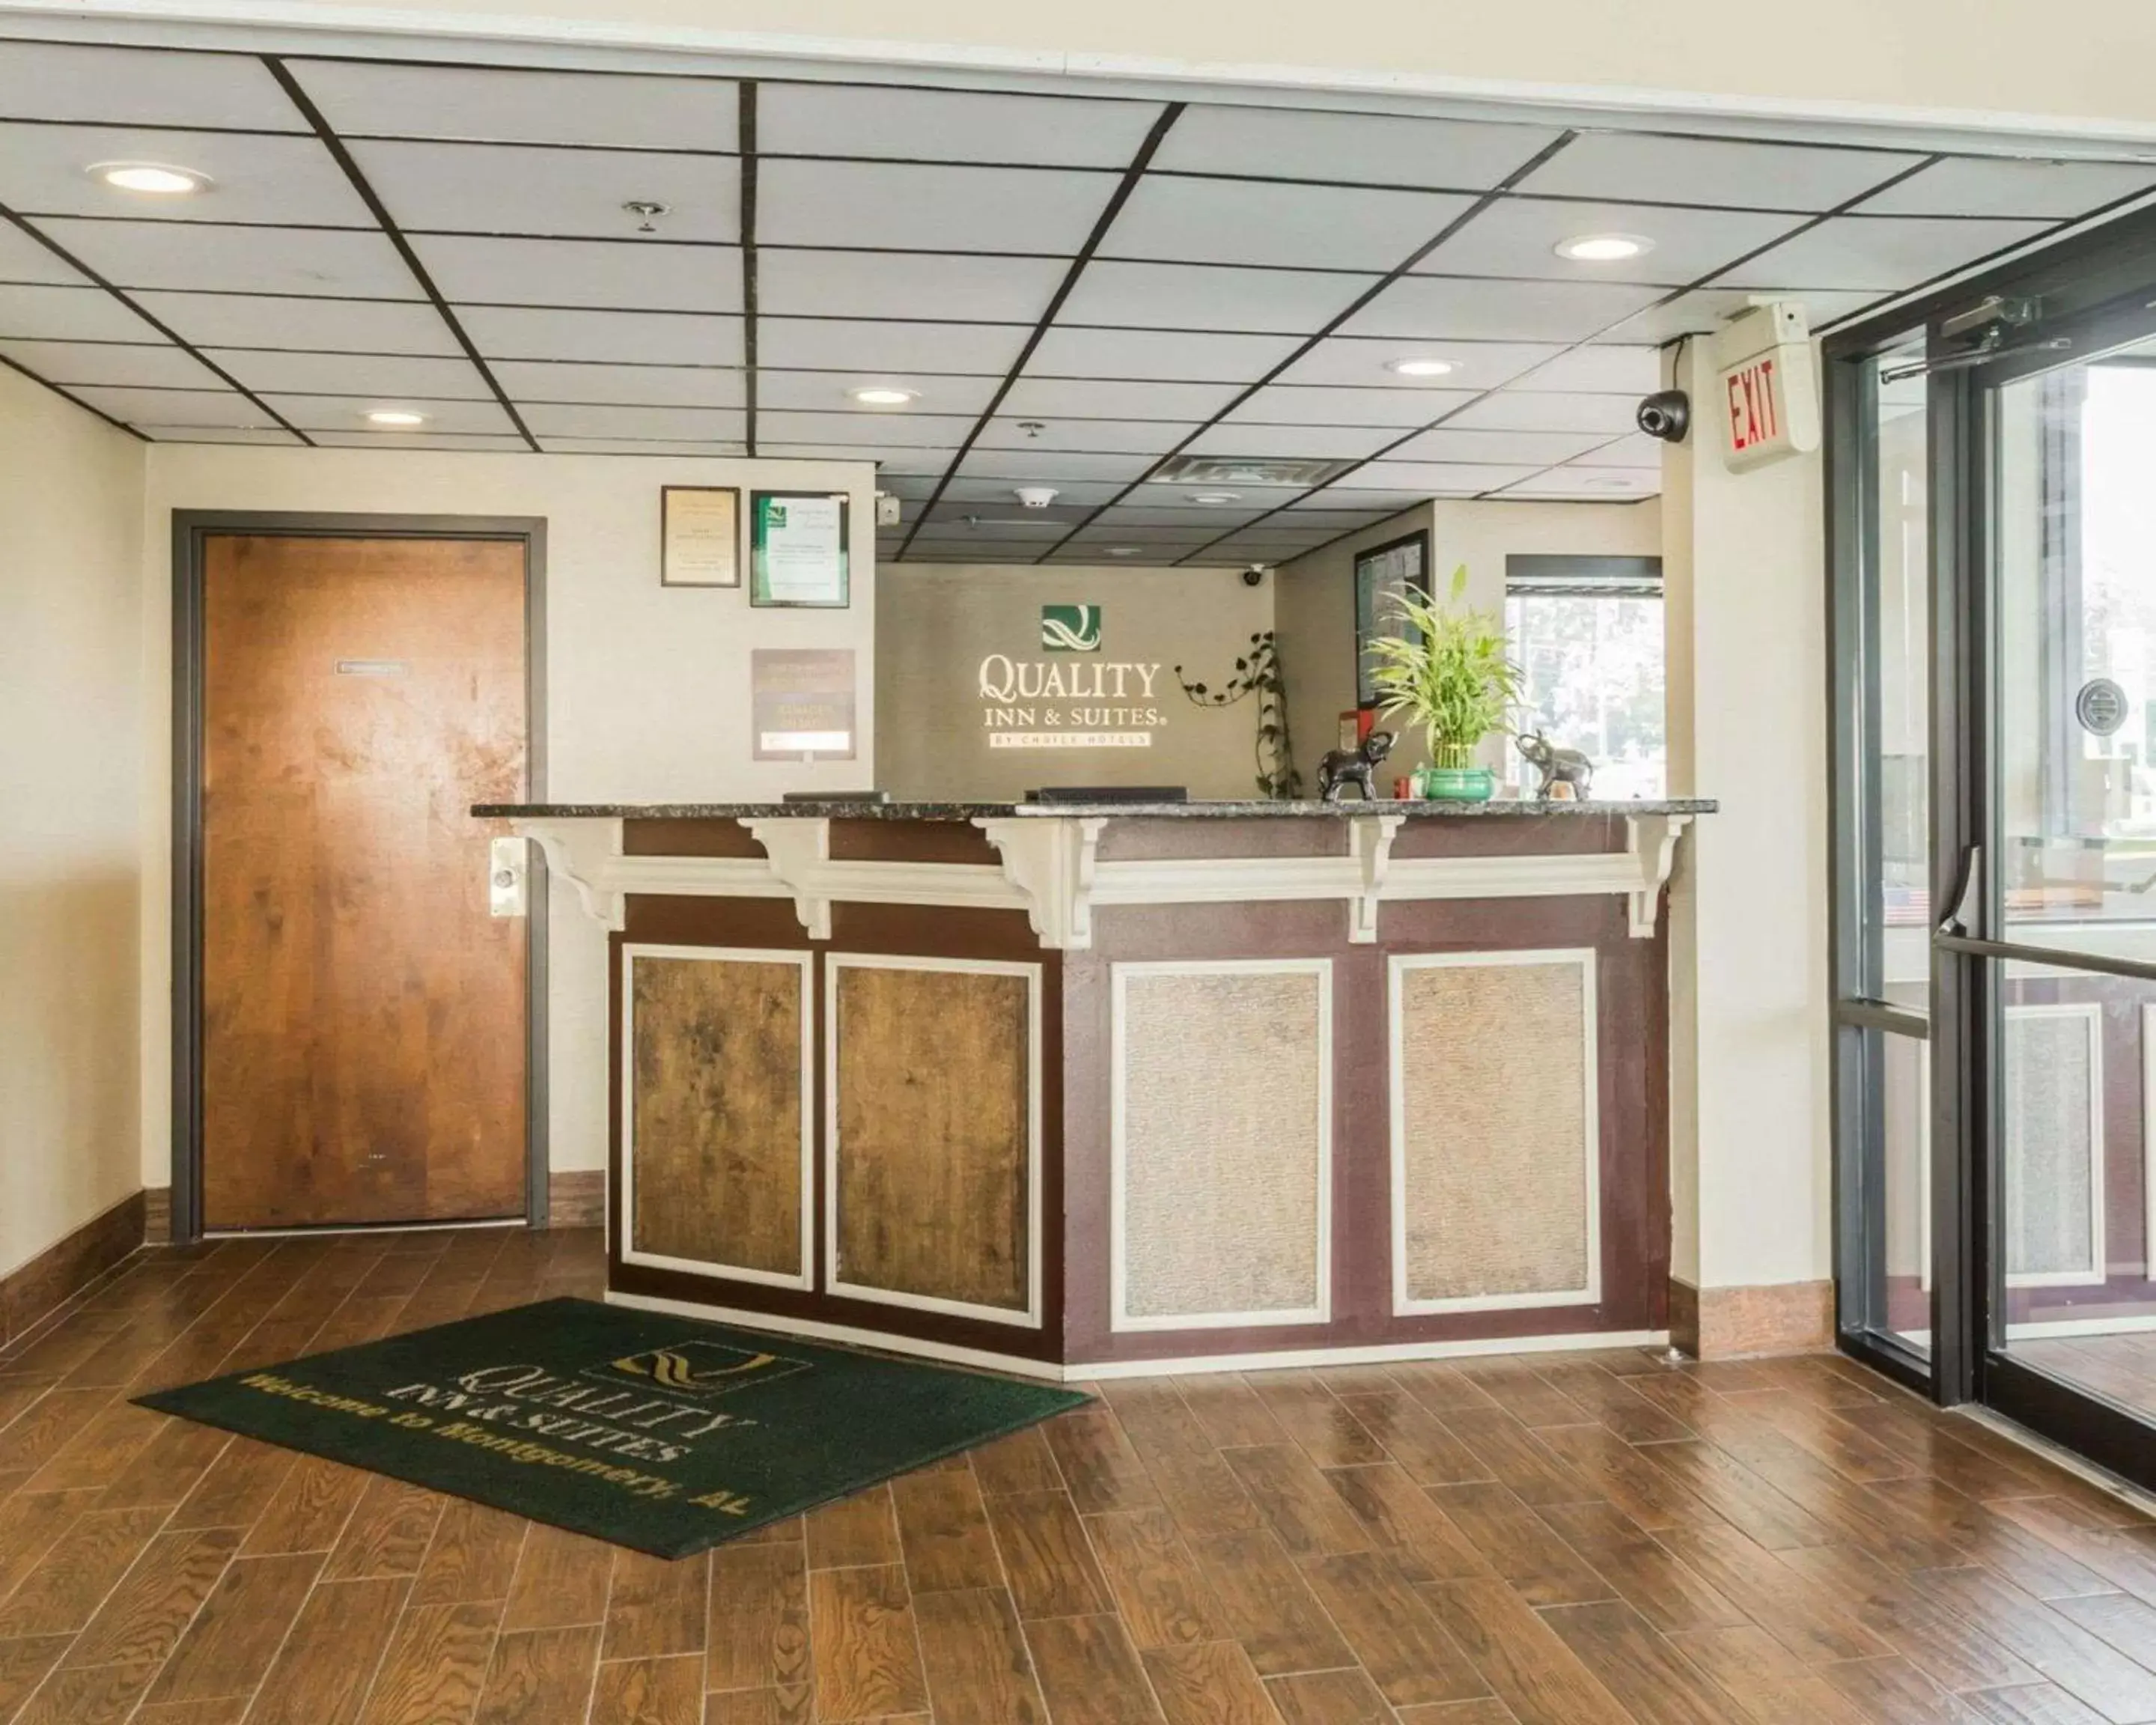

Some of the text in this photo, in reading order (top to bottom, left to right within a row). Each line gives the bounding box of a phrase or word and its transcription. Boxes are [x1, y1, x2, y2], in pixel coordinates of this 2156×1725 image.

[1727, 359, 1776, 449] EXIT
[978, 654, 1161, 703] QUALITY
[984, 708, 1036, 726] INN
[1044, 708, 1062, 726] &
[457, 1364, 735, 1439] QUALITY
[239, 1373, 390, 1417] Welcome
[388, 1412, 433, 1429] to
[687, 1491, 749, 1516] AL
[508, 1413, 692, 1462] SUITES
